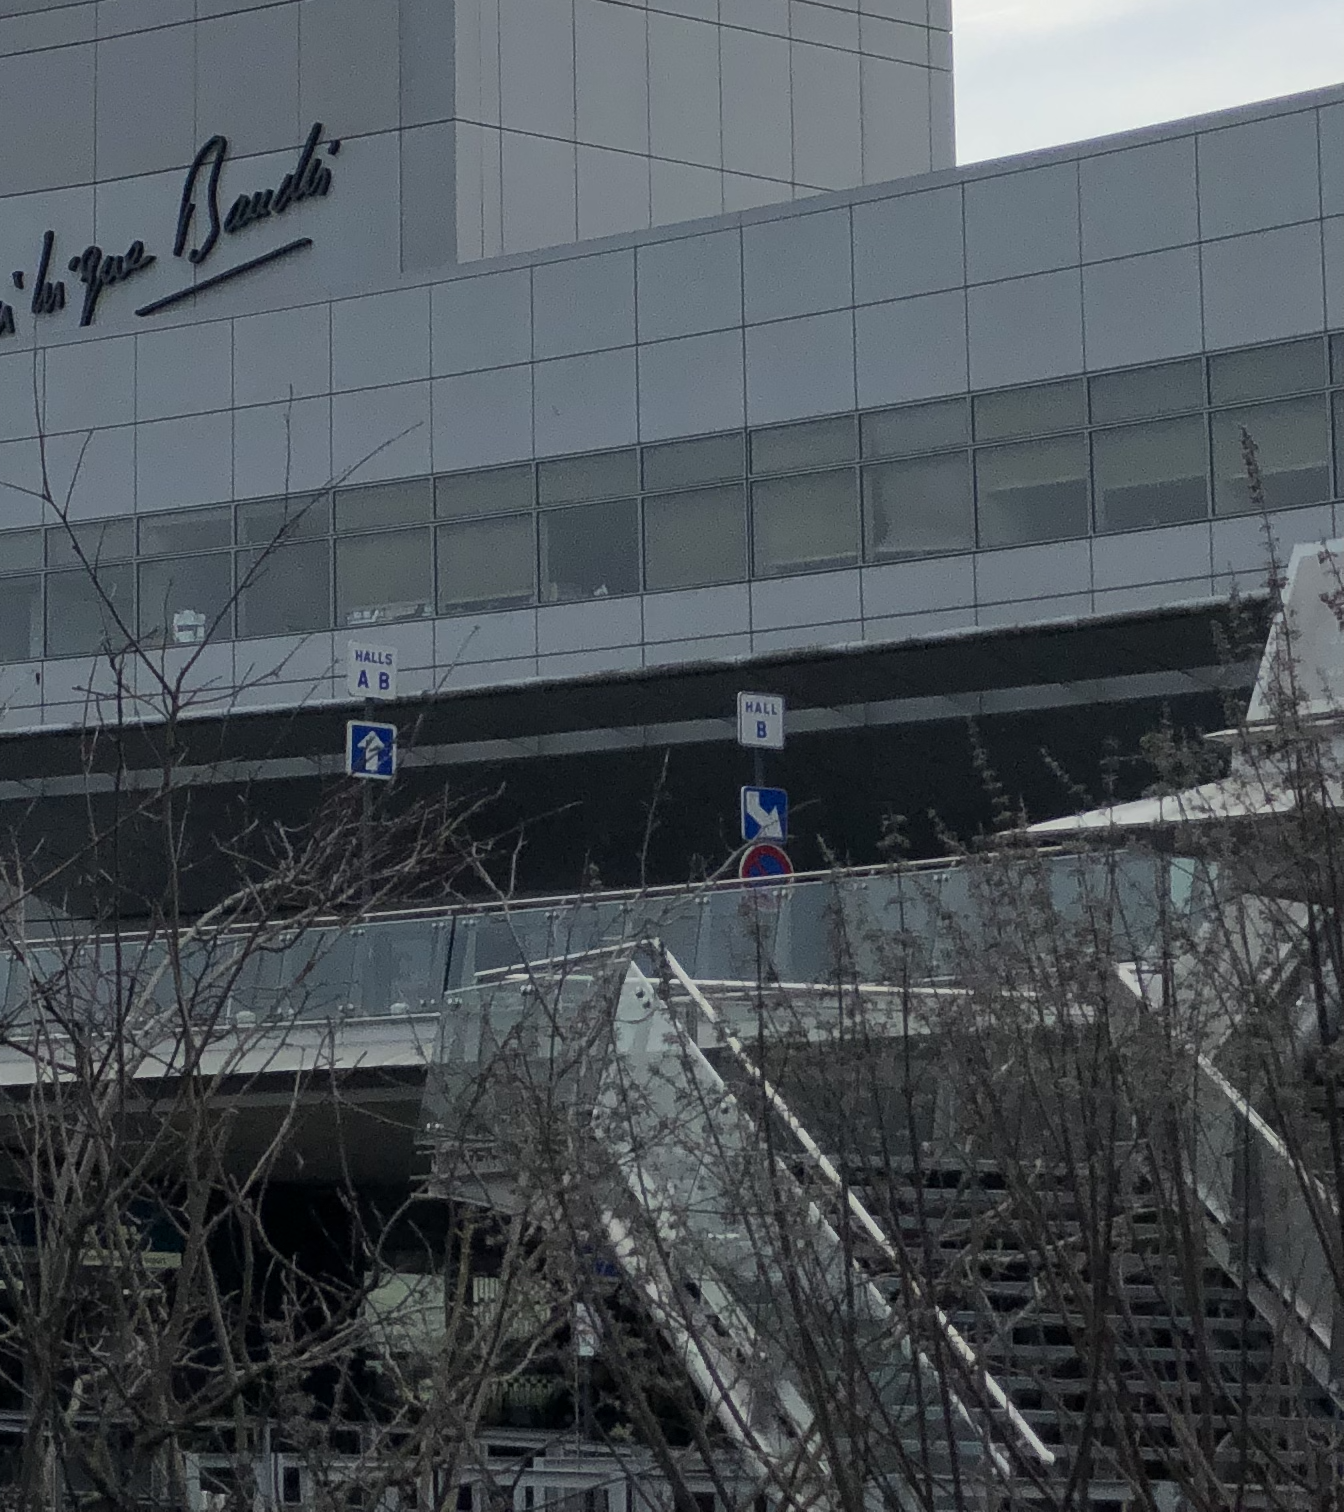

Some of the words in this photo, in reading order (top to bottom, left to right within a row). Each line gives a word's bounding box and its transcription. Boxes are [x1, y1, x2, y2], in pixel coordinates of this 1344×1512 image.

[354, 649, 393, 666] HALLS
[358, 669, 370, 688] A
[378, 671, 391, 690] B
[745, 701, 779, 716] HALL
[756, 721, 768, 739] B
